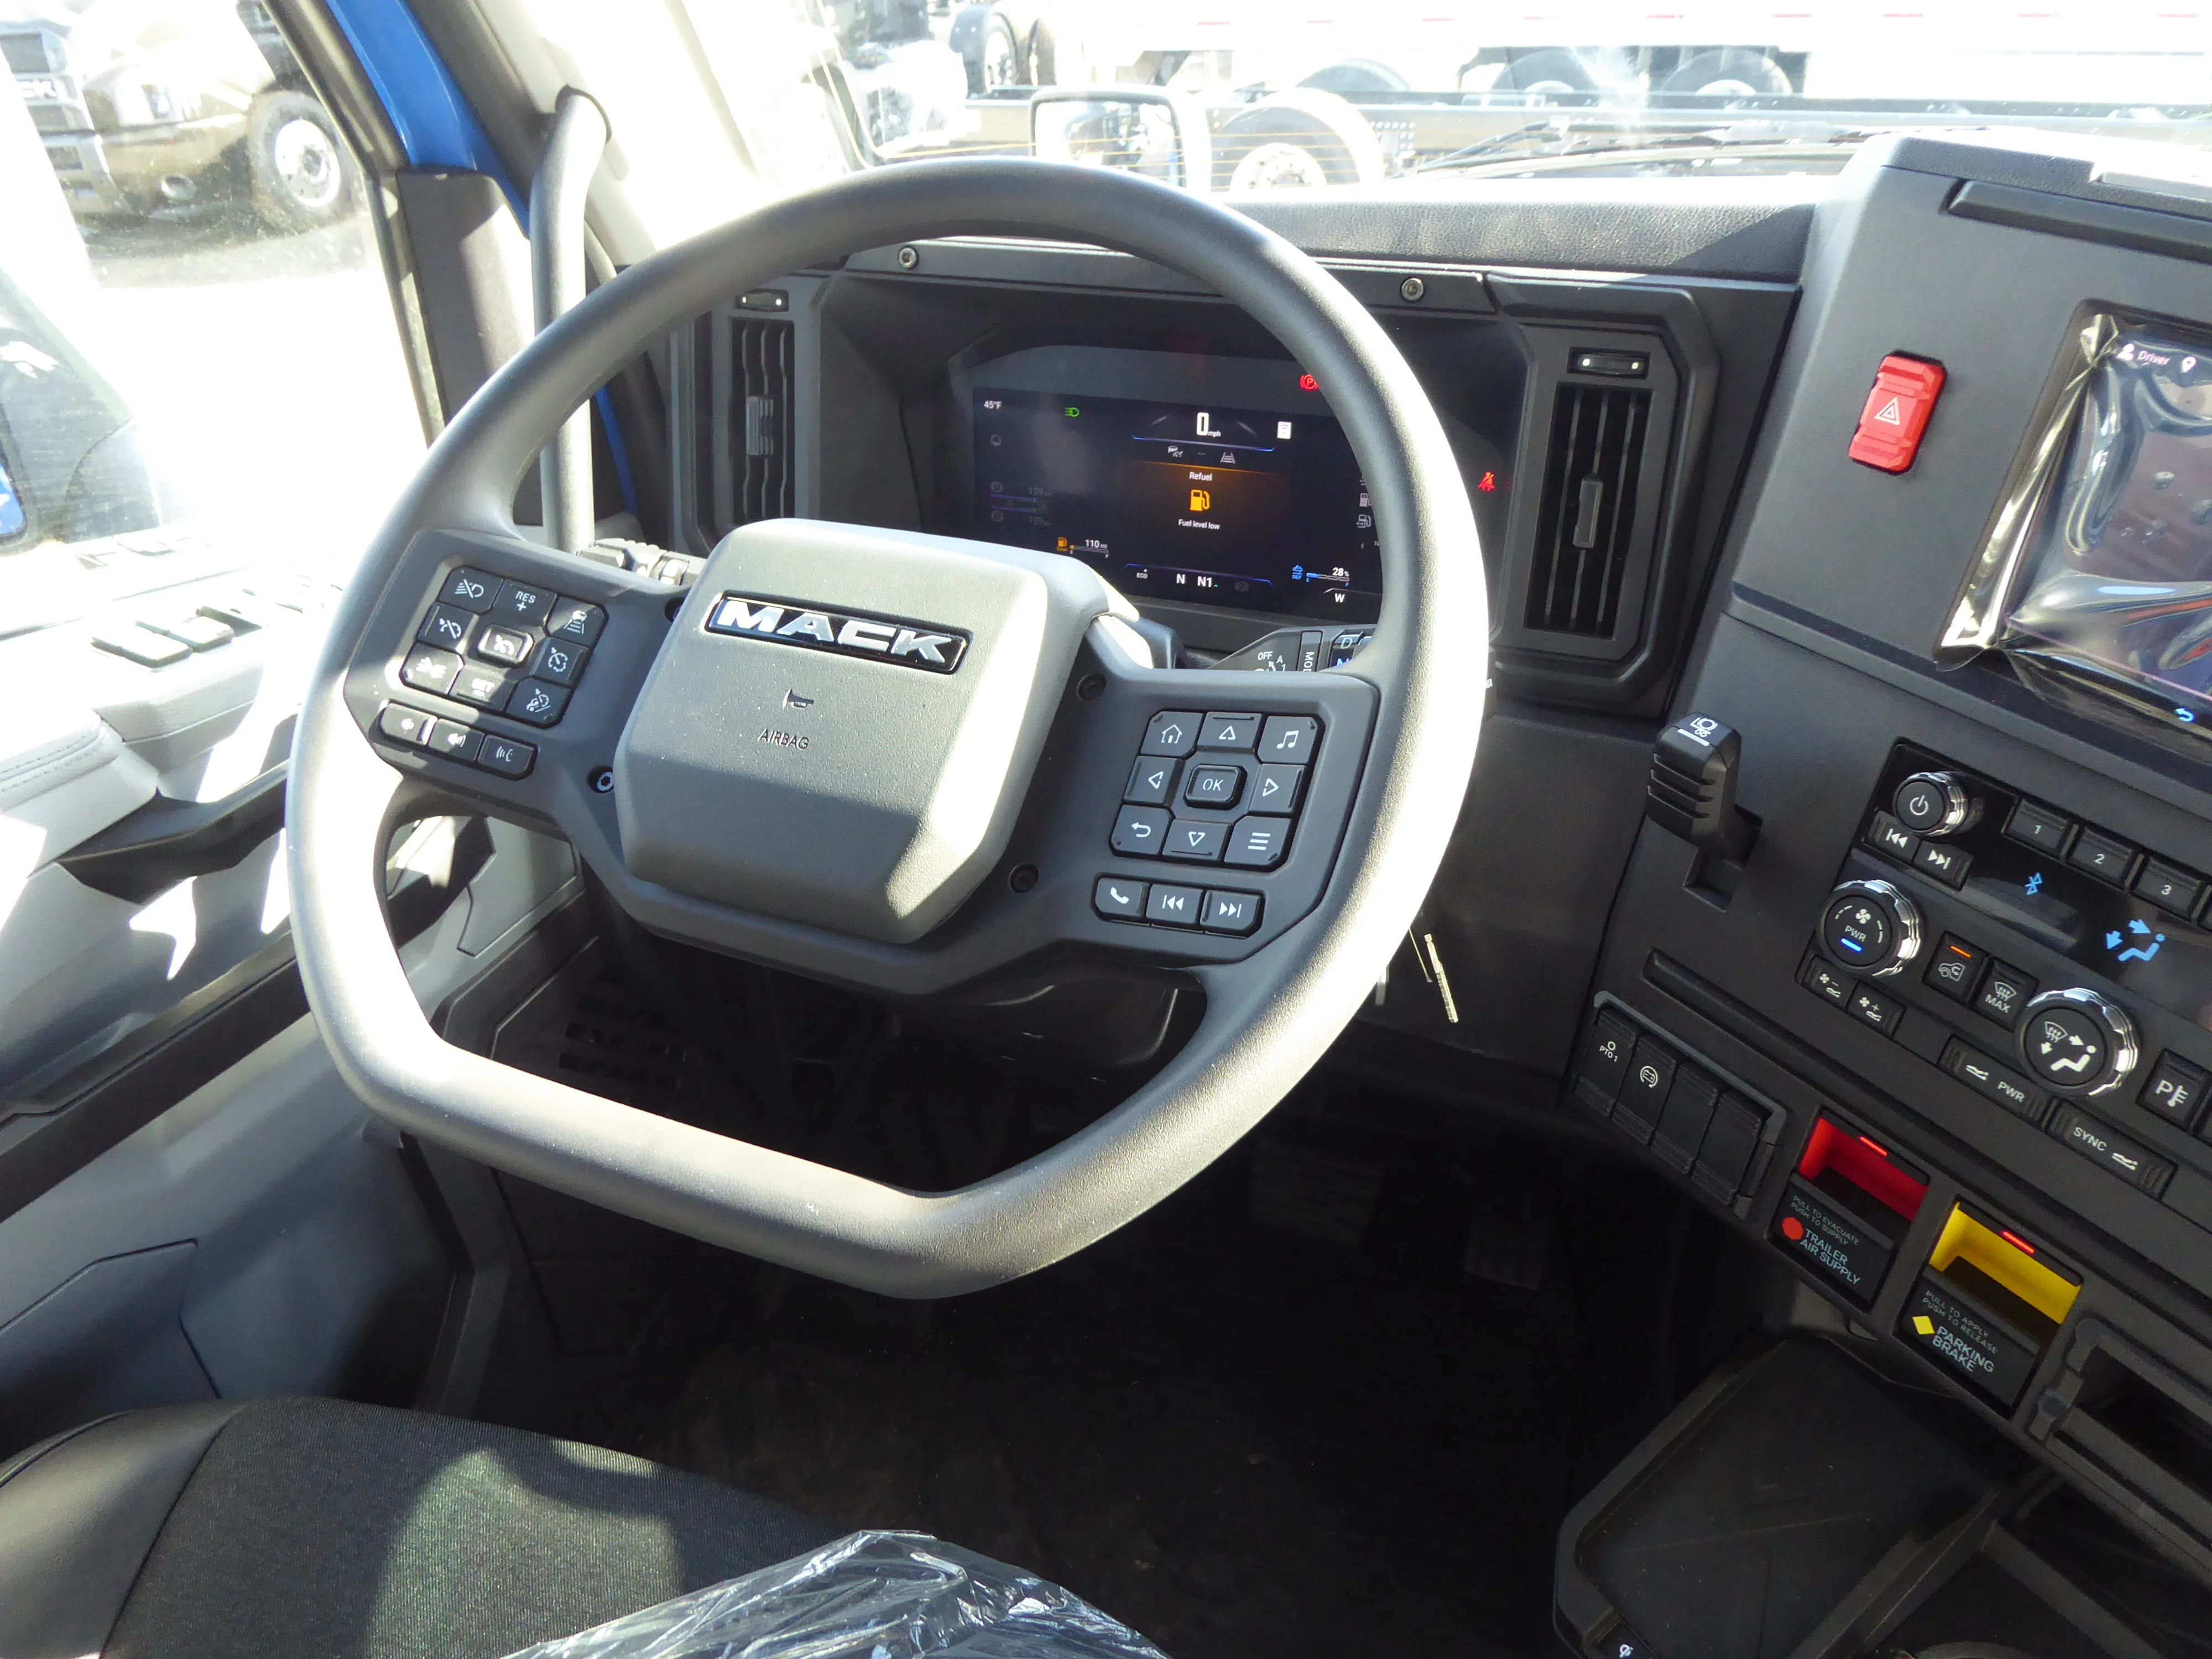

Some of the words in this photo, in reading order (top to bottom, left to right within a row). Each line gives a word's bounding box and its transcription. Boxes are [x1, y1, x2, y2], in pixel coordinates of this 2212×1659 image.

[2138, 350, 2171, 366] Driver
[984, 400, 1002, 409] 45°F
[1189, 471, 1213, 482] Refuel
[1178, 519, 1192, 527] Fuel
[1193, 520, 1207, 529] level
[1208, 521, 1220, 530] low
[1085, 539, 1100, 548] 110
[1176, 573, 1186, 584] N
[1197, 576, 1213, 588] N1
[515, 591, 536, 604] RES
[1334, 592, 1345, 603] W
[717, 599, 952, 663] MACK
[1340, 637, 1353, 650] D
[1257, 651, 1273, 661] OFF
[1276, 655, 1283, 664] A
[757, 728, 810, 750] AIRBAG
[1202, 777, 1224, 792] OK
[2034, 825, 2042, 834] 1
[2094, 853, 2105, 864] 2
[2161, 884, 2172, 895] 3
[1844, 925, 1867, 942] PWR
[1985, 994, 2011, 1014] MAX
[1599, 1045, 1613, 1058] PTO
[1997, 1081, 2025, 1103] PWR
[2073, 1126, 2107, 1151] SYNC
[1791, 1202, 1810, 1218] PUSH
[1812, 1215, 1821, 1226] TO
[1821, 1223, 1849, 1245] SUPPLY
[1792, 1196, 1810, 1211] PULL
[1812, 1208, 1822, 1218] TO
[1822, 1216, 1860, 1245] EVACUATE
[1806, 1228, 1848, 1265] TRAILER
[1799, 1239, 1819, 1256] AIR
[1819, 1251, 1861, 1285] SUPPLY
[1926, 1290, 1945, 1309] PULL
[1949, 1307, 1960, 1317] TO
[1962, 1317, 1989, 1337] APPLY
[1922, 1297, 1945, 1316] PUSH
[1947, 1314, 1959, 1326] TO
[1960, 1324, 1998, 1354] RELEASE
[1932, 1335, 1976, 1372] BRAKE
[1937, 1326, 1995, 1373] PARKING
